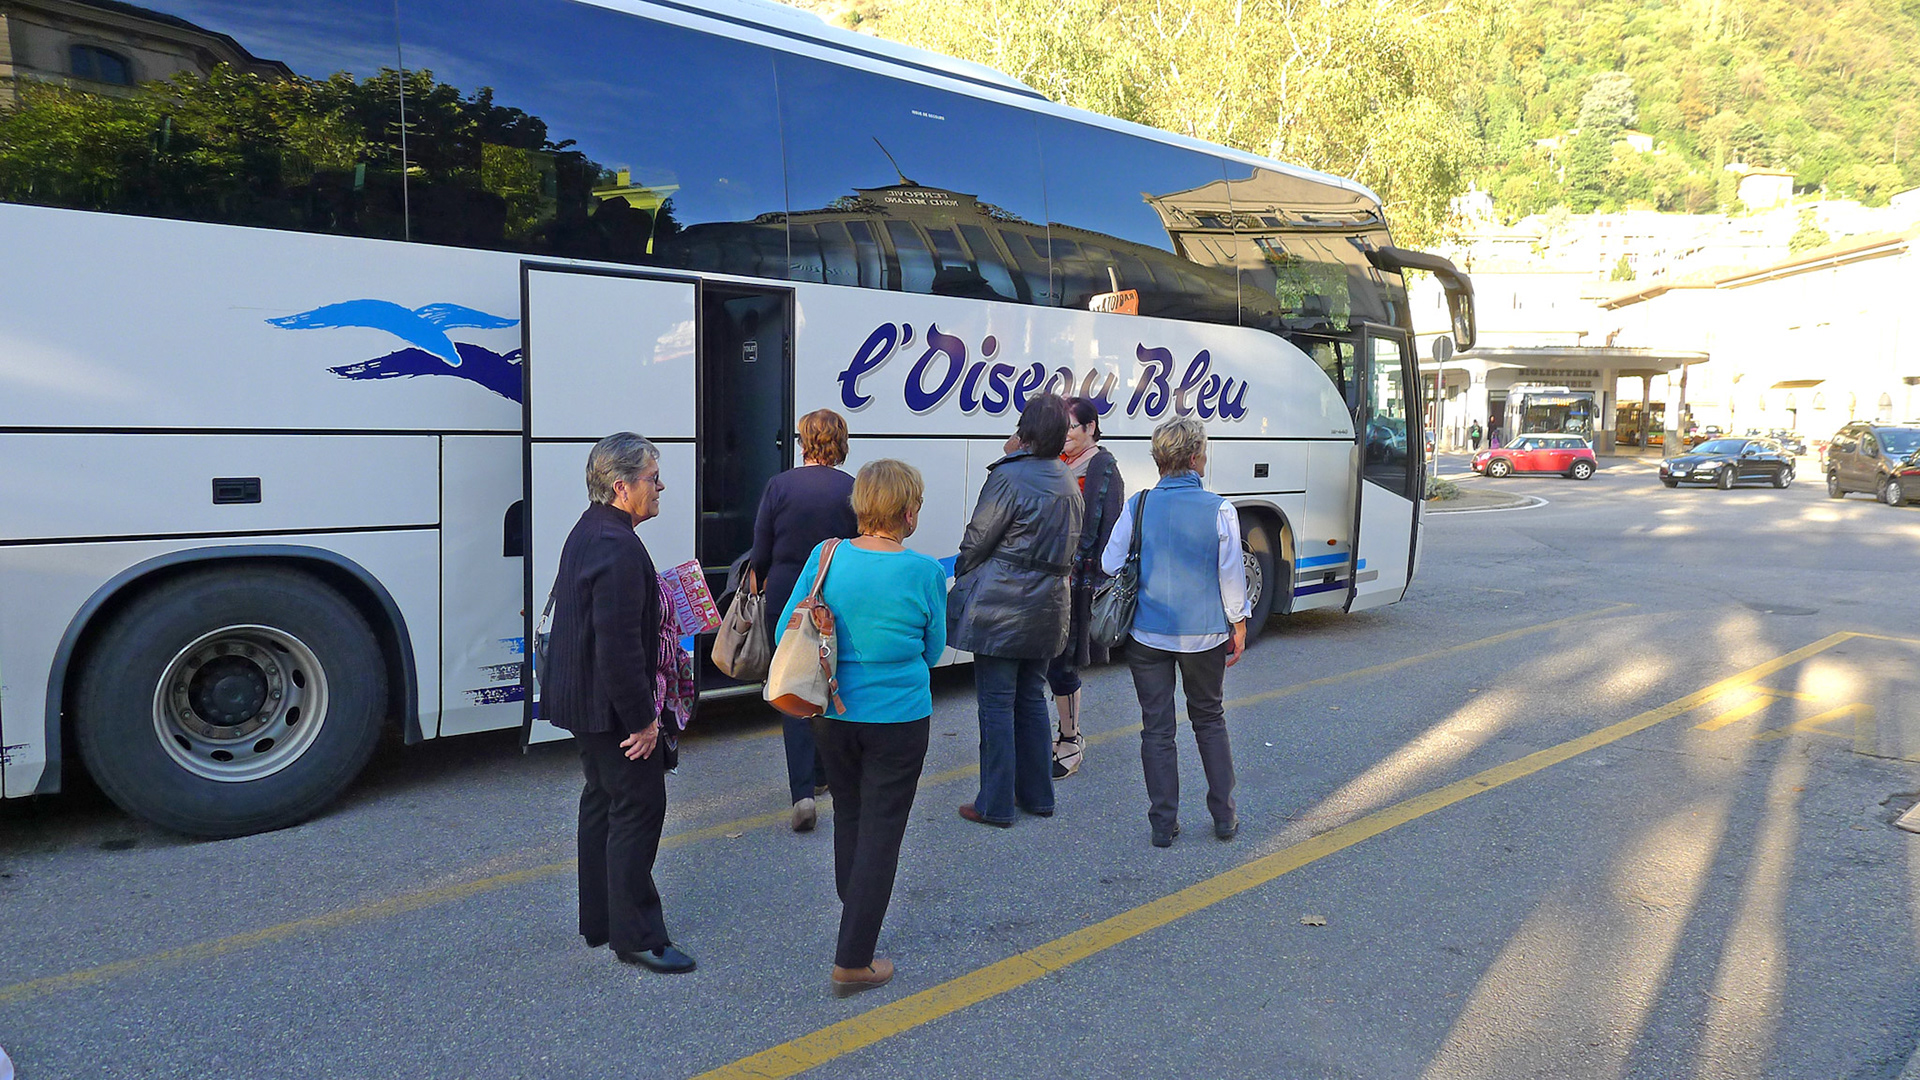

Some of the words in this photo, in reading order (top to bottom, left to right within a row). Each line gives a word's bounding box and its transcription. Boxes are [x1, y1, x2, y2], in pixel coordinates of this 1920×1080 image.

[1127, 341, 1249, 421] Bleu
[1518, 368, 1600, 377] BIGLIETTERIA
[677, 567, 703, 617] Natale
[688, 565, 719, 626] SPECIALE
